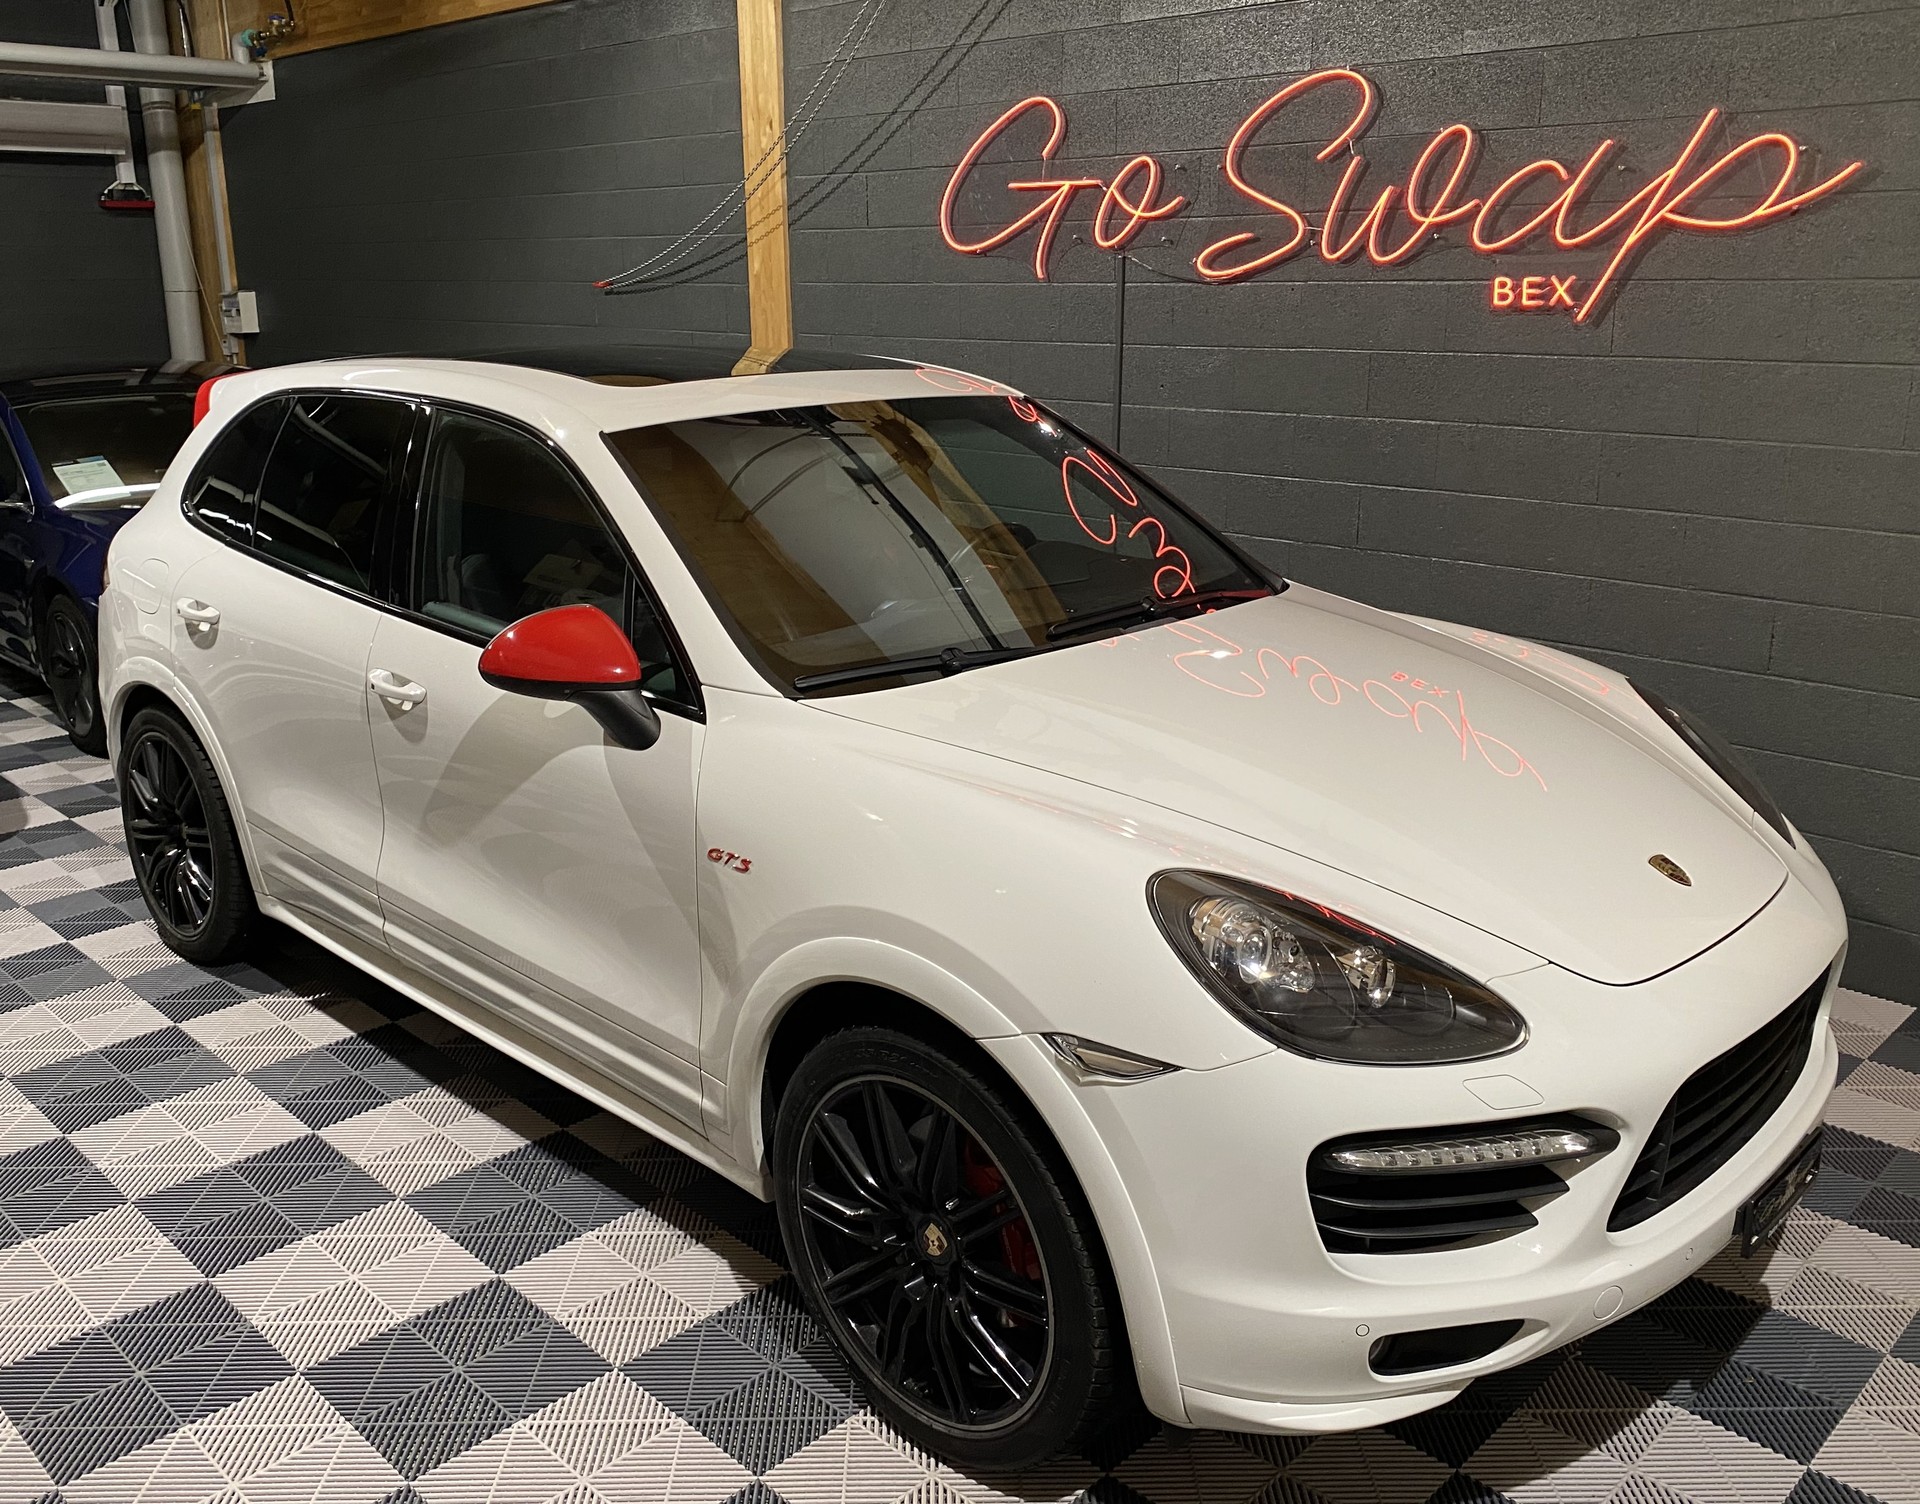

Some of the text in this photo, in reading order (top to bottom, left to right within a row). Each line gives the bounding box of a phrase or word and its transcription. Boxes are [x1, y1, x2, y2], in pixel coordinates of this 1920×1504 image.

[939, 67, 1863, 323] Go Swap
[1491, 274, 1577, 308] BEX
[706, 847, 753, 874] GTS
